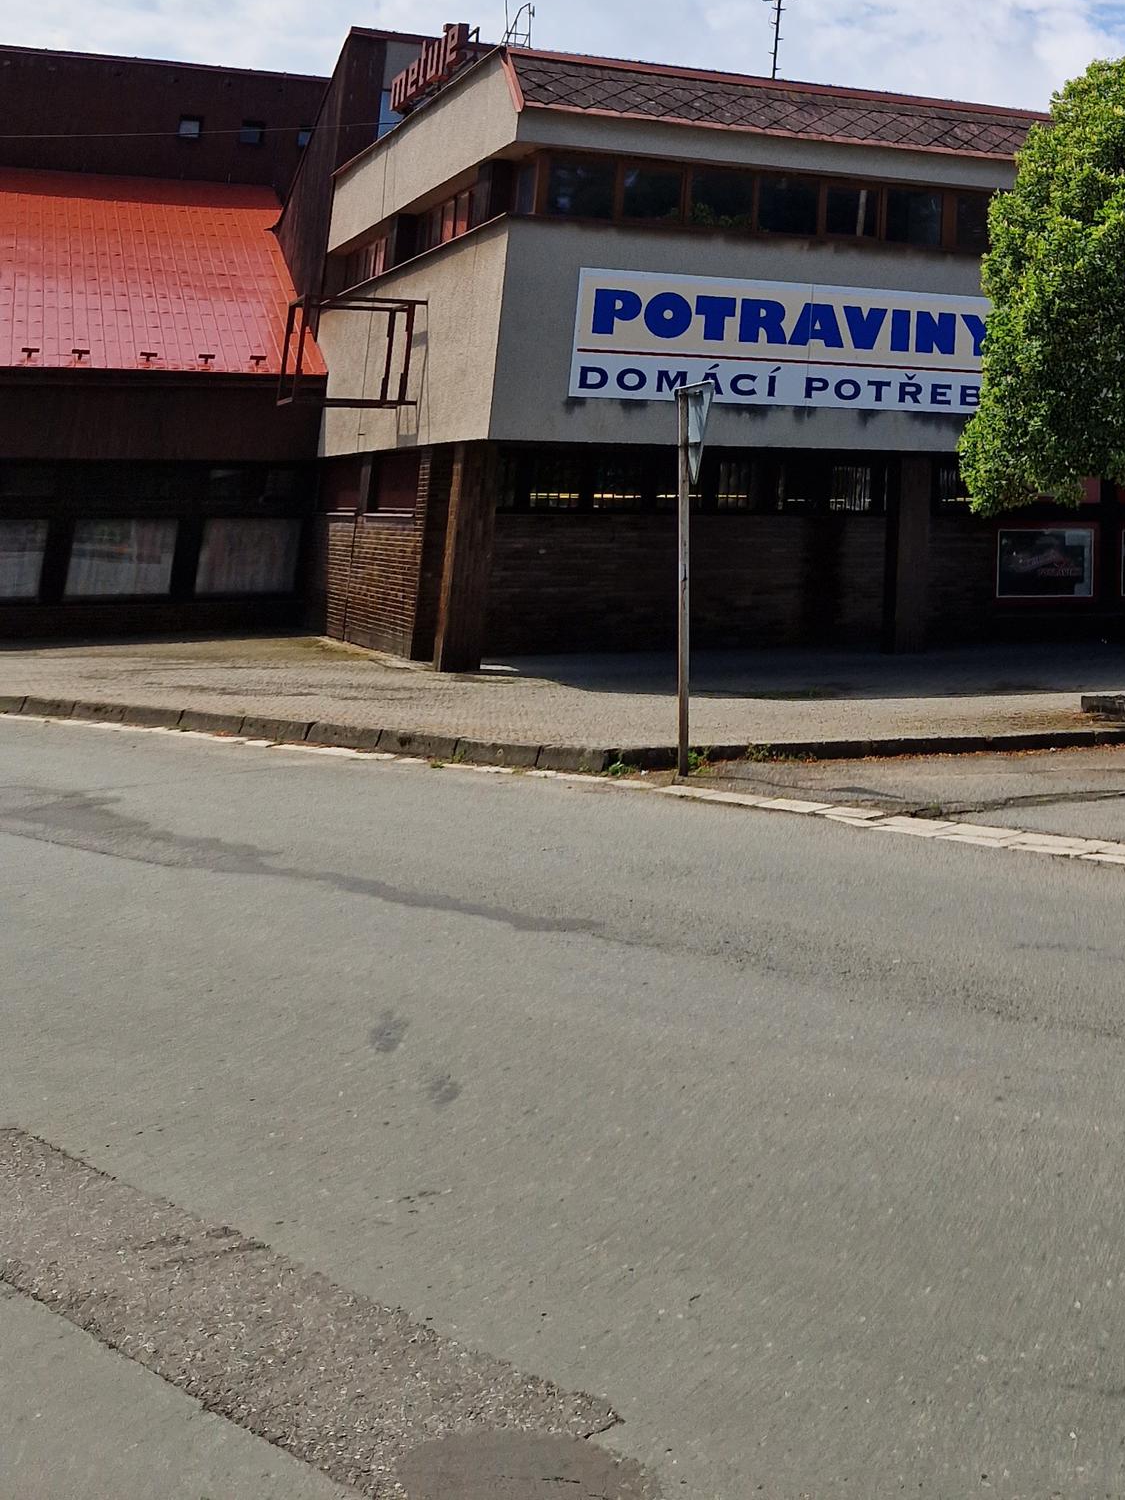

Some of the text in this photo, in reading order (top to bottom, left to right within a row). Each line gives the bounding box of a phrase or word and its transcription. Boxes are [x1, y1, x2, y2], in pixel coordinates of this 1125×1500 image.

[591, 287, 986, 357] POTRAVINY
[578, 363, 980, 407] DOMÁCÍ POTŘEB
